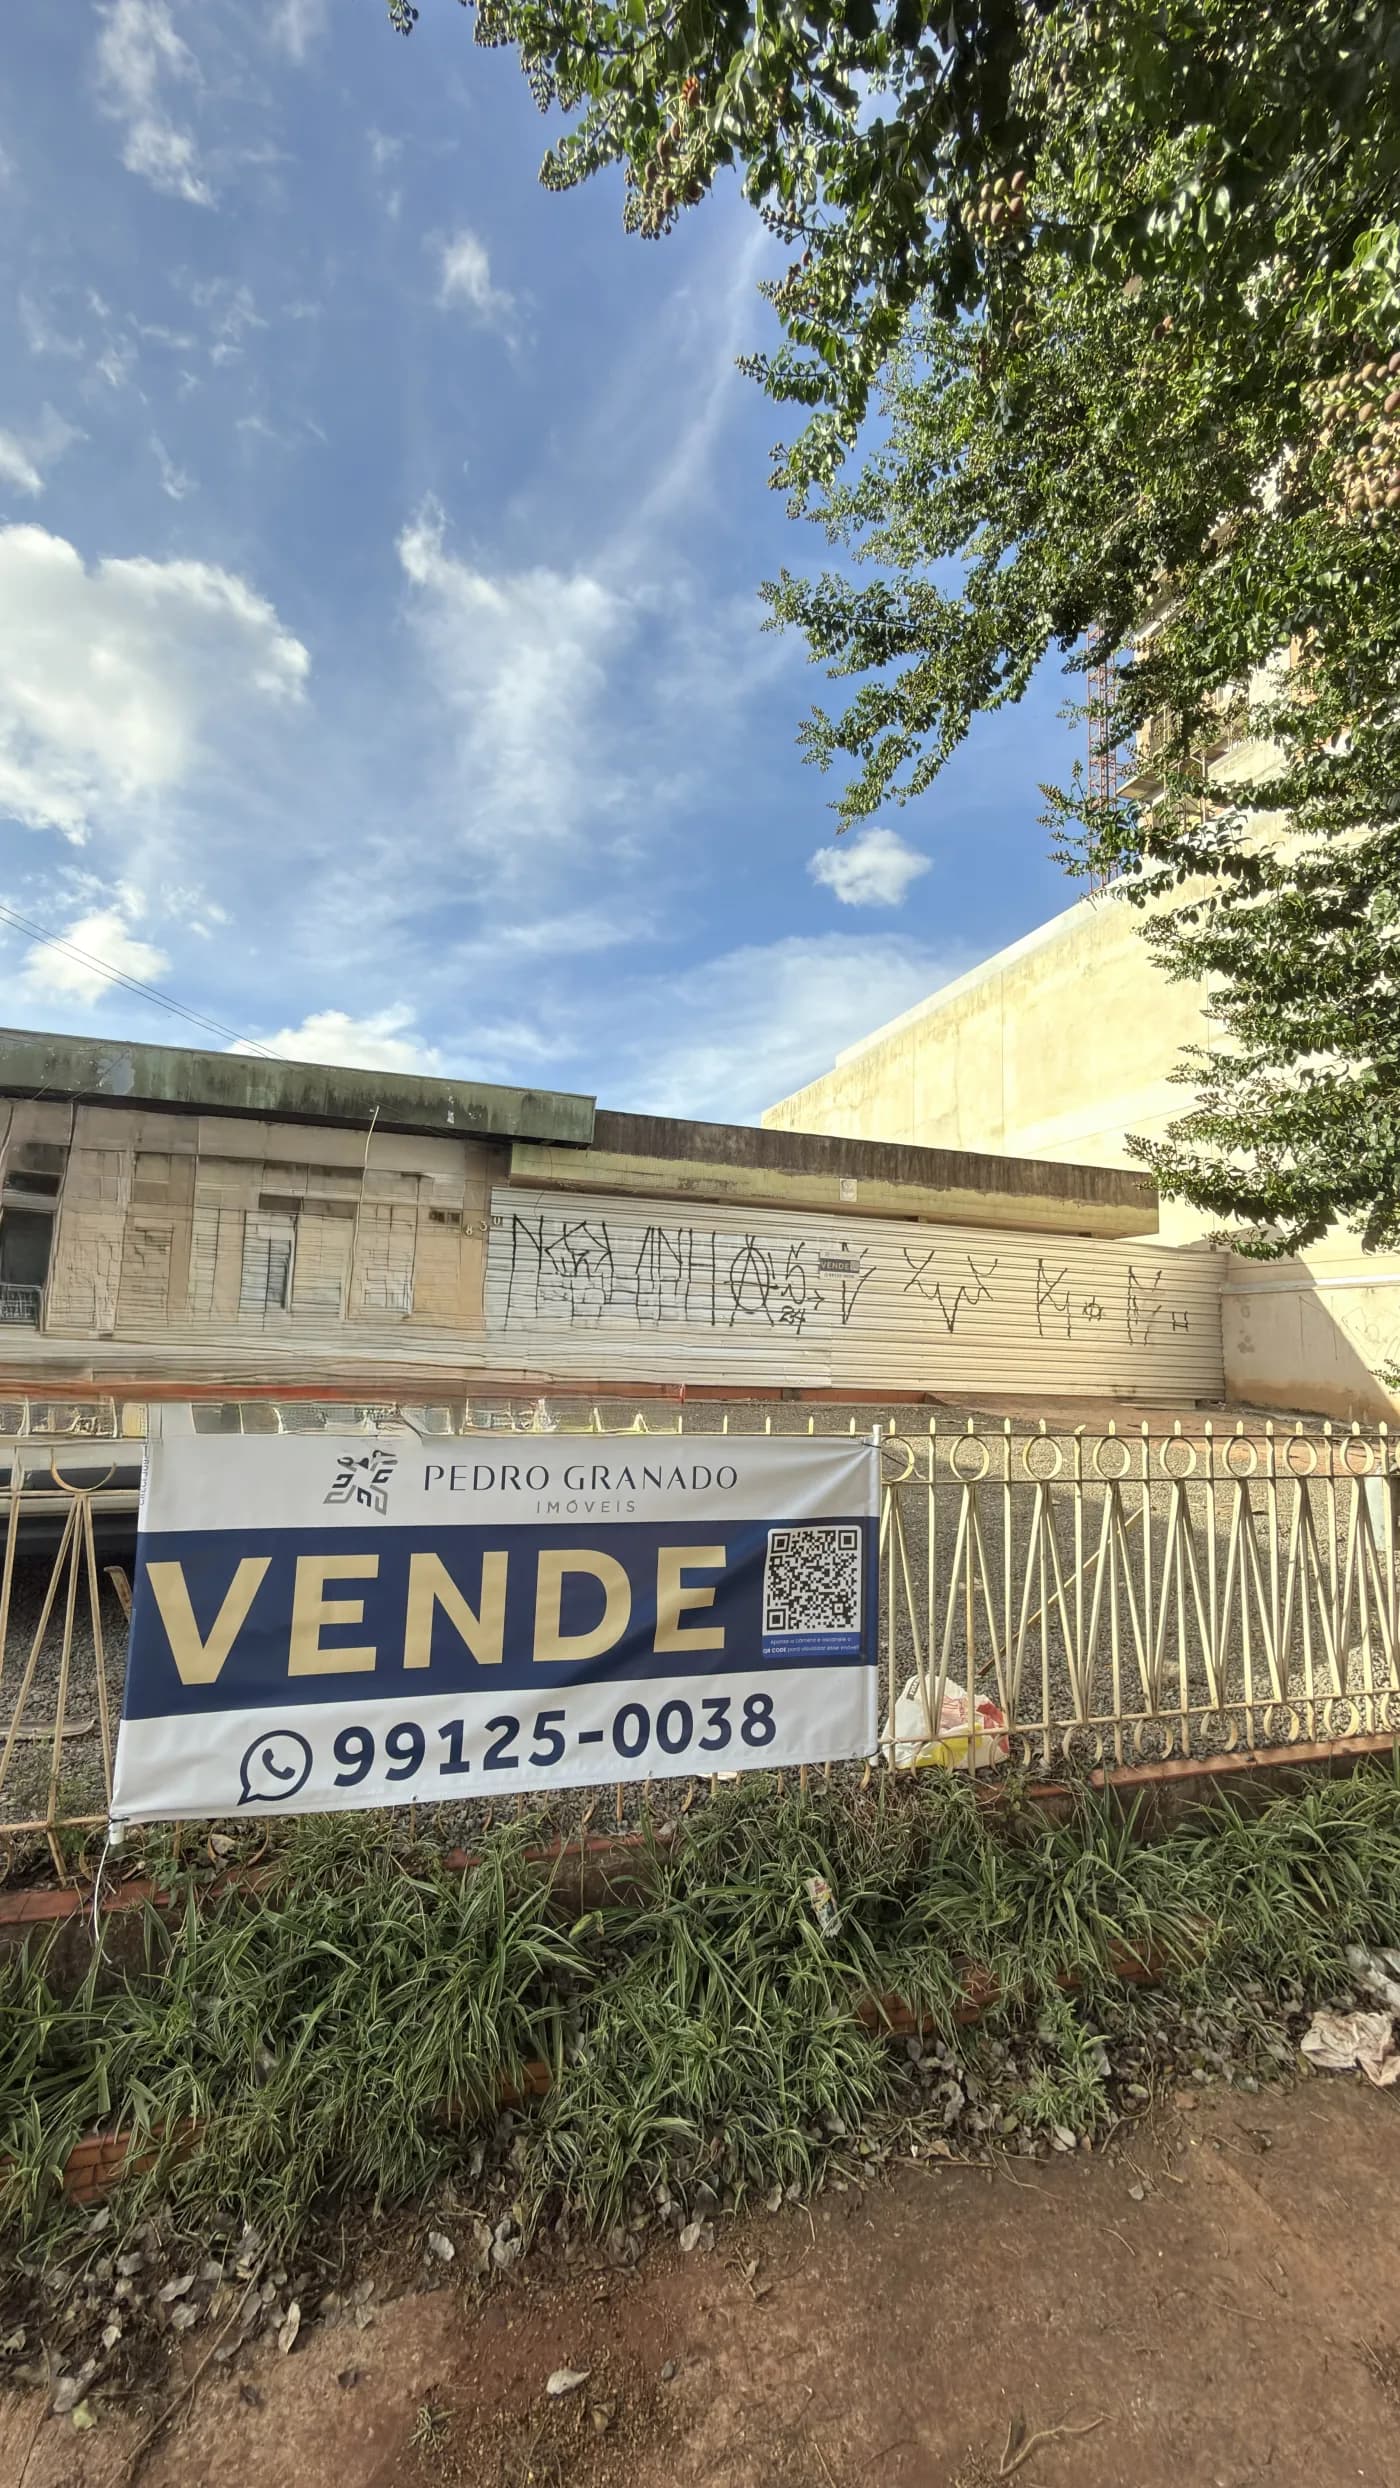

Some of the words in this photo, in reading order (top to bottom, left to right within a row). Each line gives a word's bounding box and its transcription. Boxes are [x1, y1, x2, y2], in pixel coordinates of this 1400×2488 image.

[820, 1261, 849, 1270] VENDE
[424, 1465, 549, 1491] PEDRO
[563, 1465, 738, 1490] GRANADO
[536, 1499, 637, 1514] IMÓVEIS
[146, 1545, 727, 1685] VENDE
[333, 1692, 778, 1787] 99125-0038
